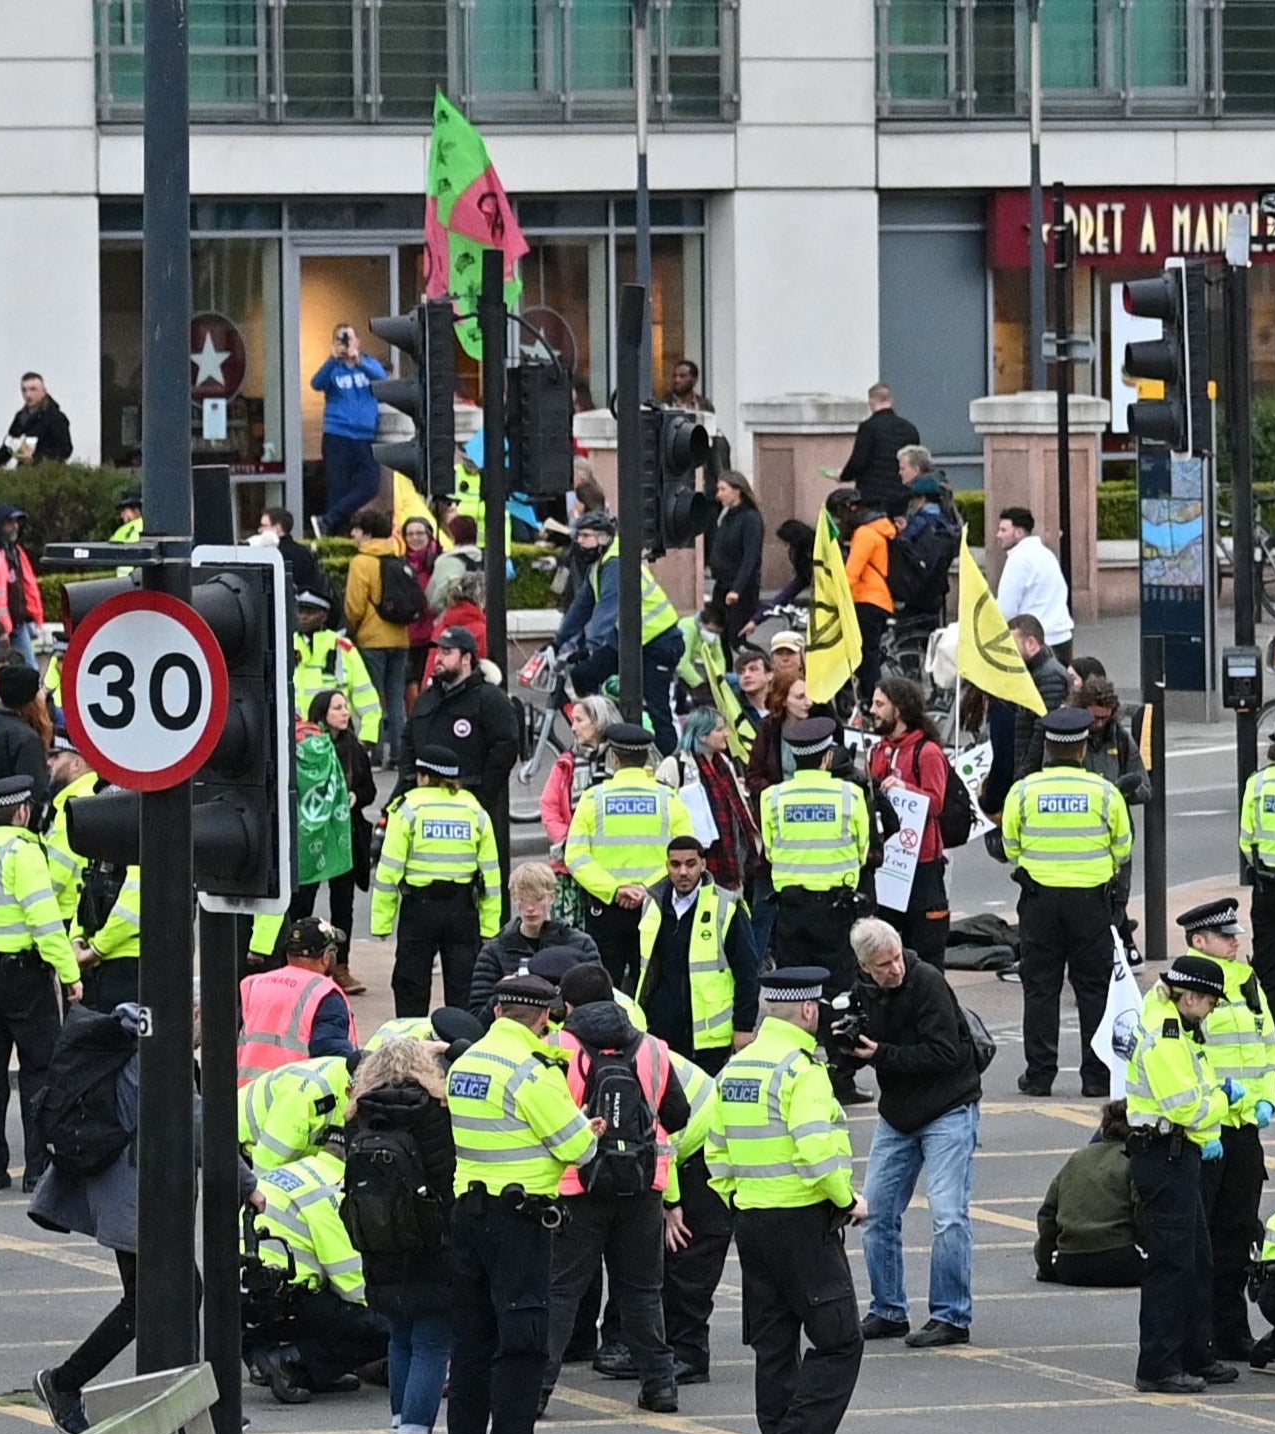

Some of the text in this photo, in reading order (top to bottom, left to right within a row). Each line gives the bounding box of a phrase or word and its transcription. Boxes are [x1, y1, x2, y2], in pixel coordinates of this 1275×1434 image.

[1140, 203, 1156, 253] A
[86, 650, 203, 731] 30
[607, 802, 655, 814] POLICE
[890, 795, 918, 814] ere
[1039, 799, 1088, 812] POLICE
[784, 810, 834, 822] POLICE
[423, 825, 470, 840] POLICE
[450, 1080, 486, 1098] POLICE
[723, 1087, 758, 1101] POLICE
